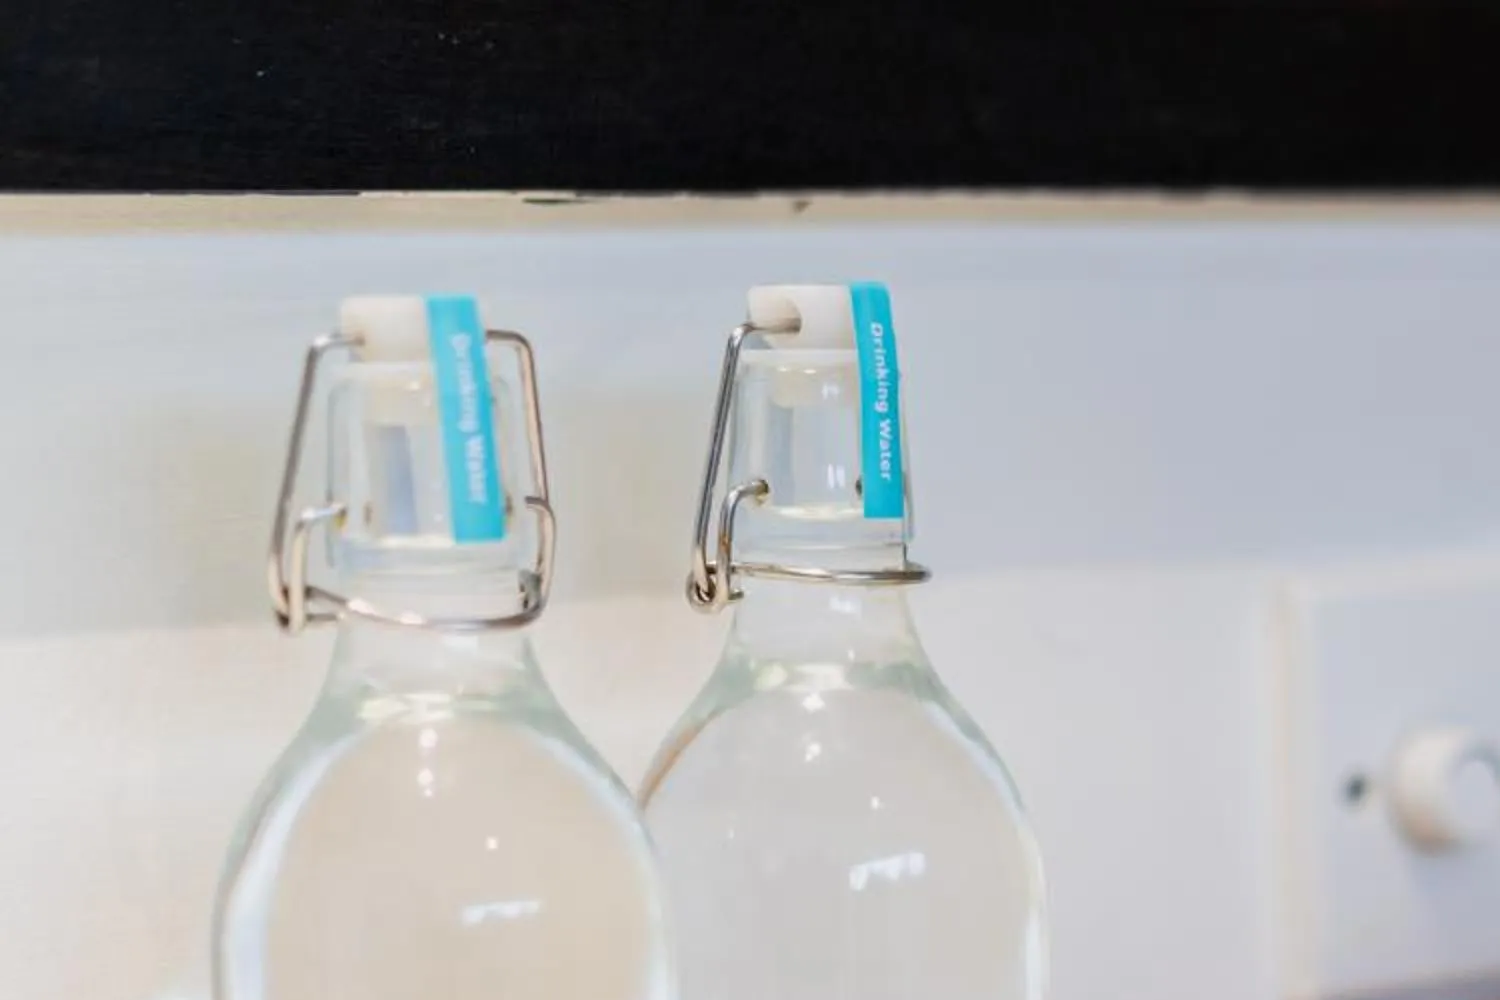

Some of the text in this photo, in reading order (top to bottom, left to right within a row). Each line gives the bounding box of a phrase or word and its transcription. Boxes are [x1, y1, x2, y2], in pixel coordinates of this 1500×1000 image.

[452, 333, 487, 504] Drinking Water
[870, 321, 892, 481] Drinking Water
